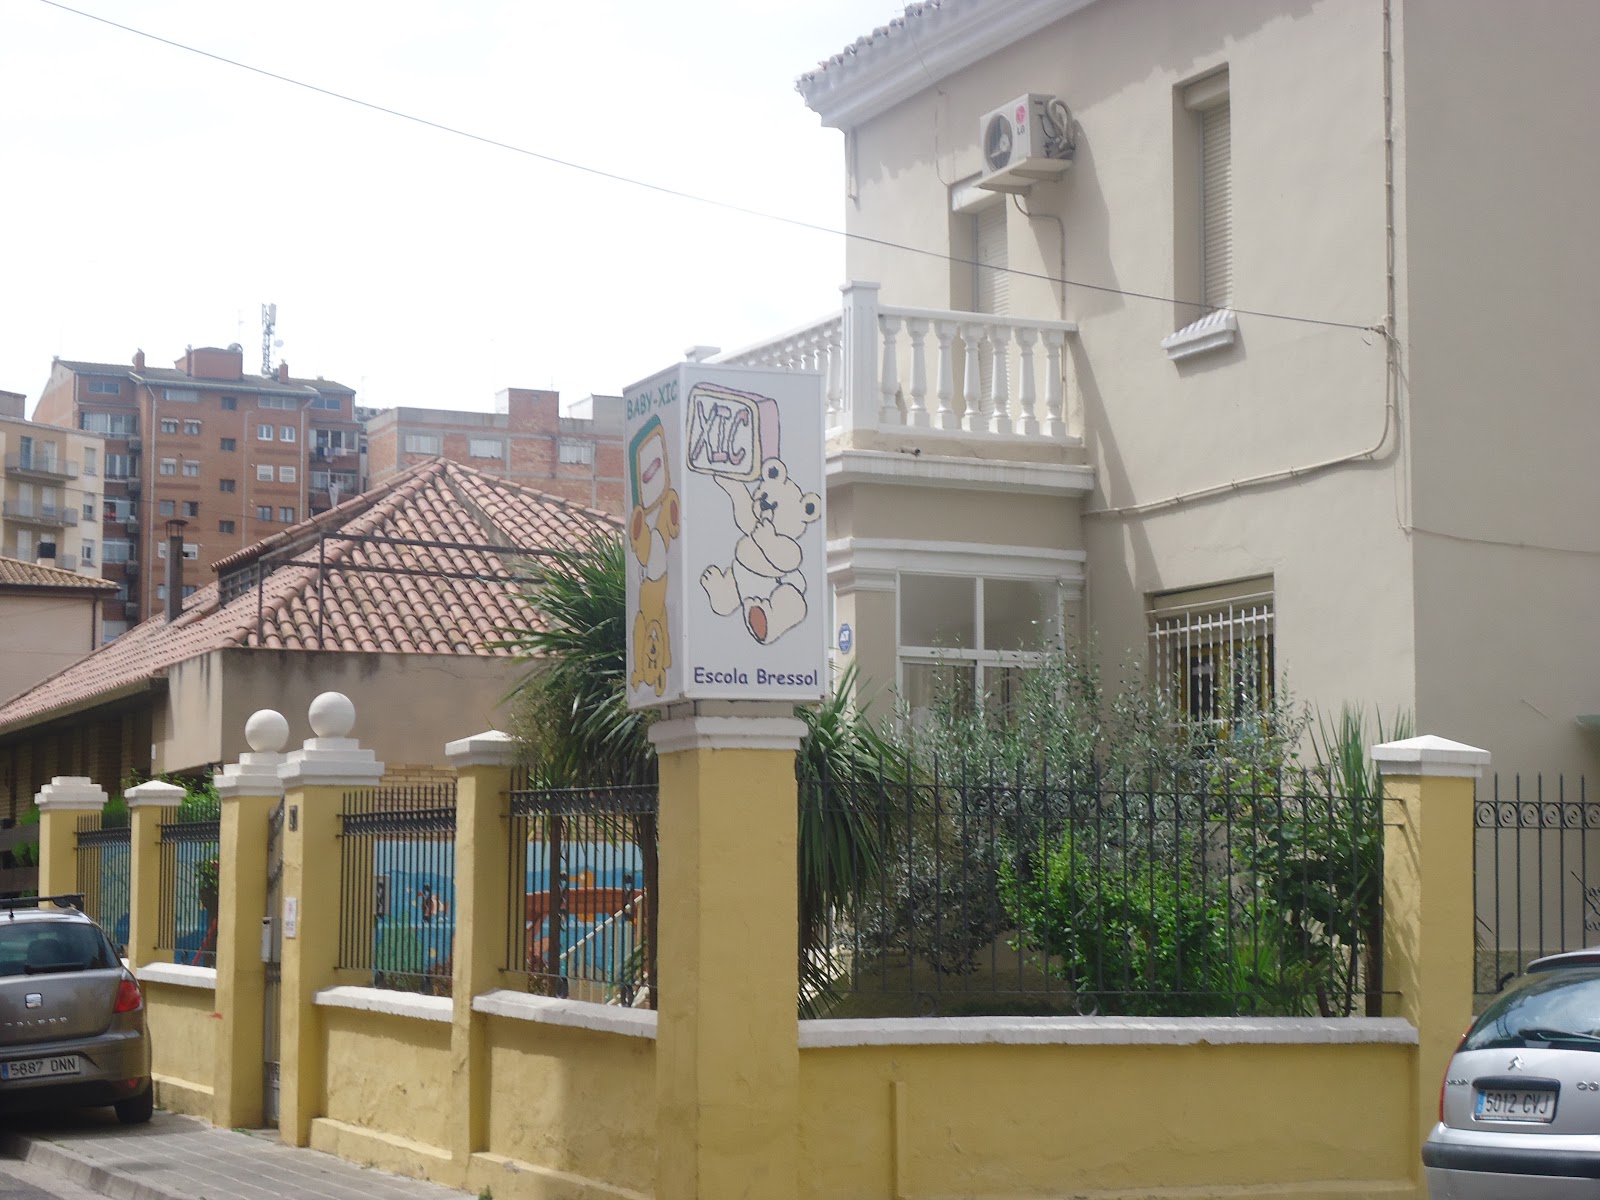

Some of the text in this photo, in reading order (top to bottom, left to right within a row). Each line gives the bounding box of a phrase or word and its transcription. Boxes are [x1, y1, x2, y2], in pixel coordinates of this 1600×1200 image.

[627, 379, 678, 420] BABY-XIC
[692, 400, 750, 466] XIC
[694, 666, 818, 686] Escola Bressol
[10, 1058, 76, 1076] 5887 DNN
[1486, 1093, 1517, 1113] 5012
